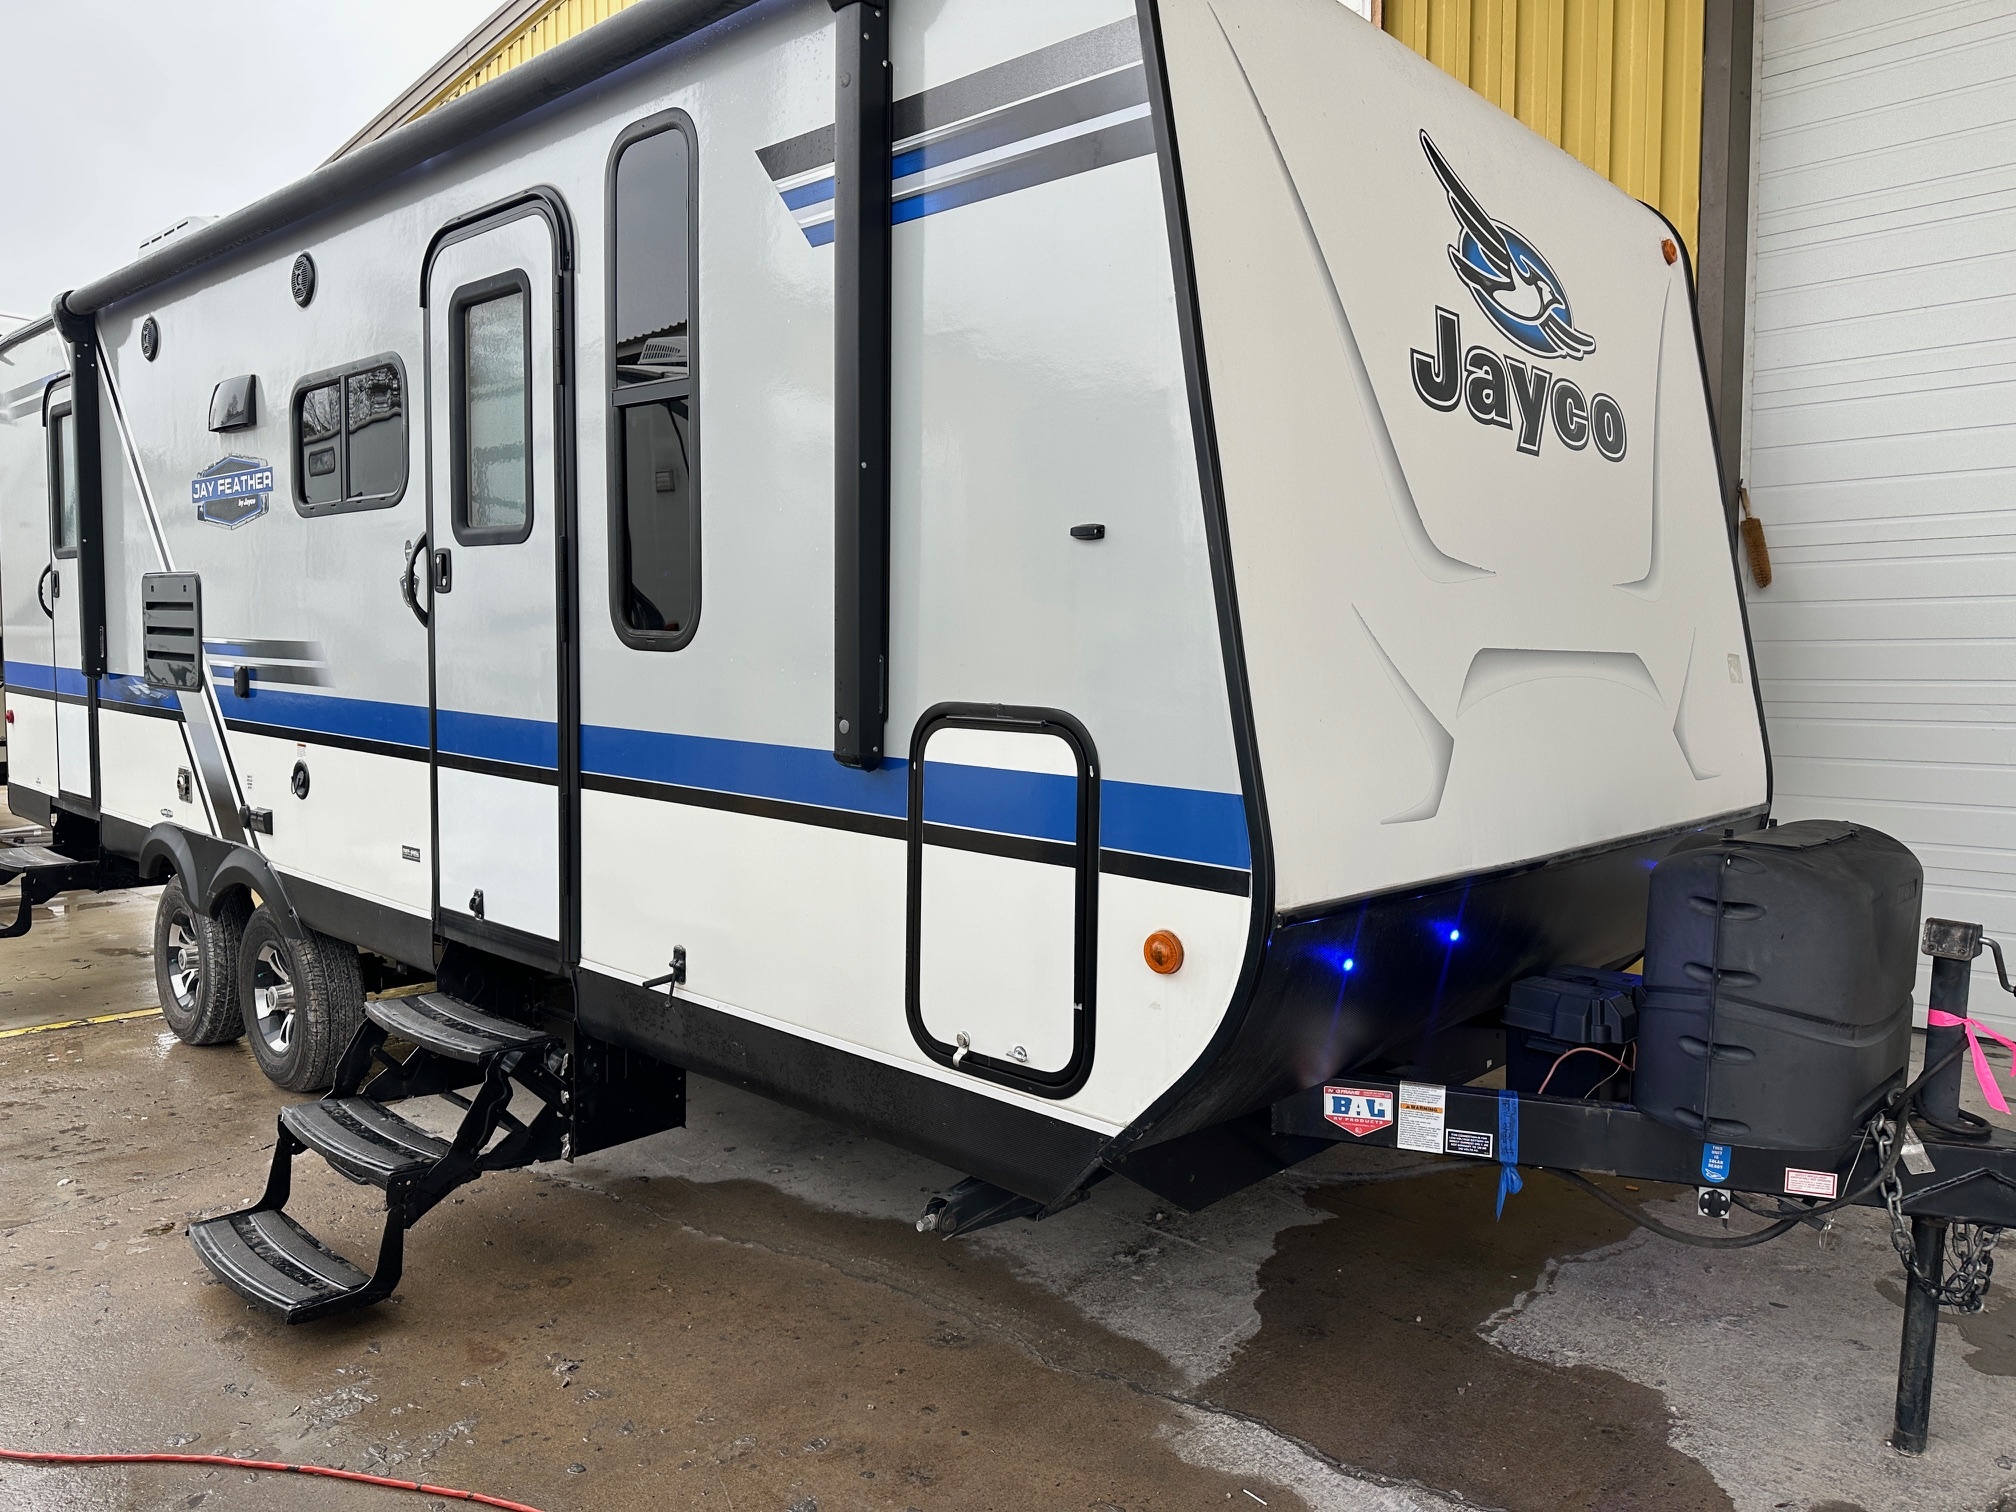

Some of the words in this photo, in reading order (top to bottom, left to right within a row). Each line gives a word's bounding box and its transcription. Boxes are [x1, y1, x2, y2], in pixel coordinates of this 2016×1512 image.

[1410, 305, 1627, 463] Jayco
[193, 481, 214, 499] JAY
[217, 471, 272, 496] FEATHER
[1332, 1096, 1385, 1118] BAL
